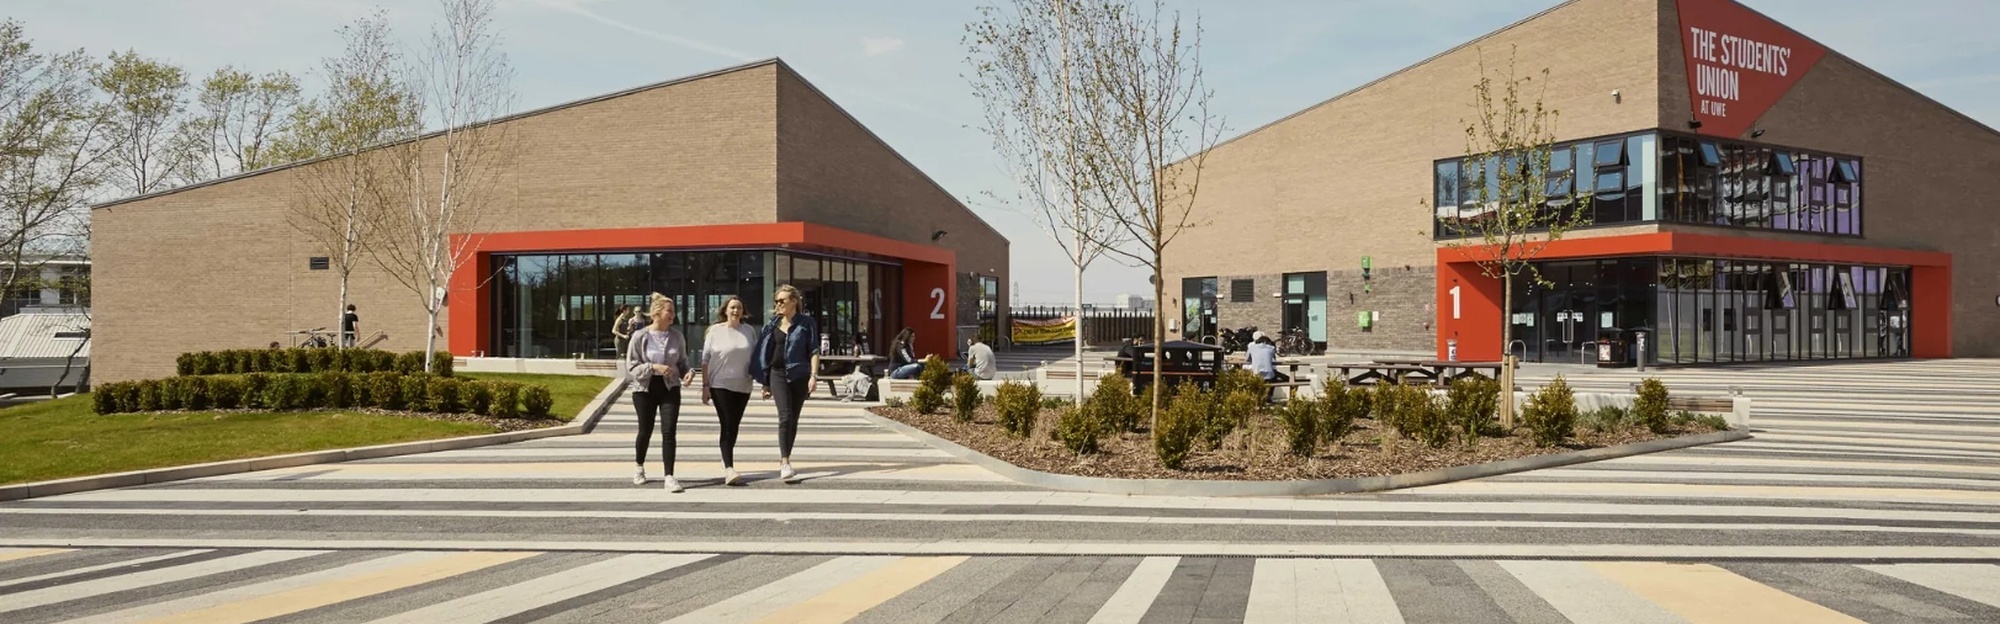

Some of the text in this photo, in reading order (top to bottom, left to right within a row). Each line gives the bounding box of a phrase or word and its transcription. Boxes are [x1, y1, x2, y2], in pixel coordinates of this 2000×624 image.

[1690, 26, 1791, 77] THE STUDENTS'
[1696, 63, 1739, 101] UNION
[1700, 99, 1727, 118] AT UWE
[930, 287, 945, 320] 2
[1448, 285, 1461, 319] 1
